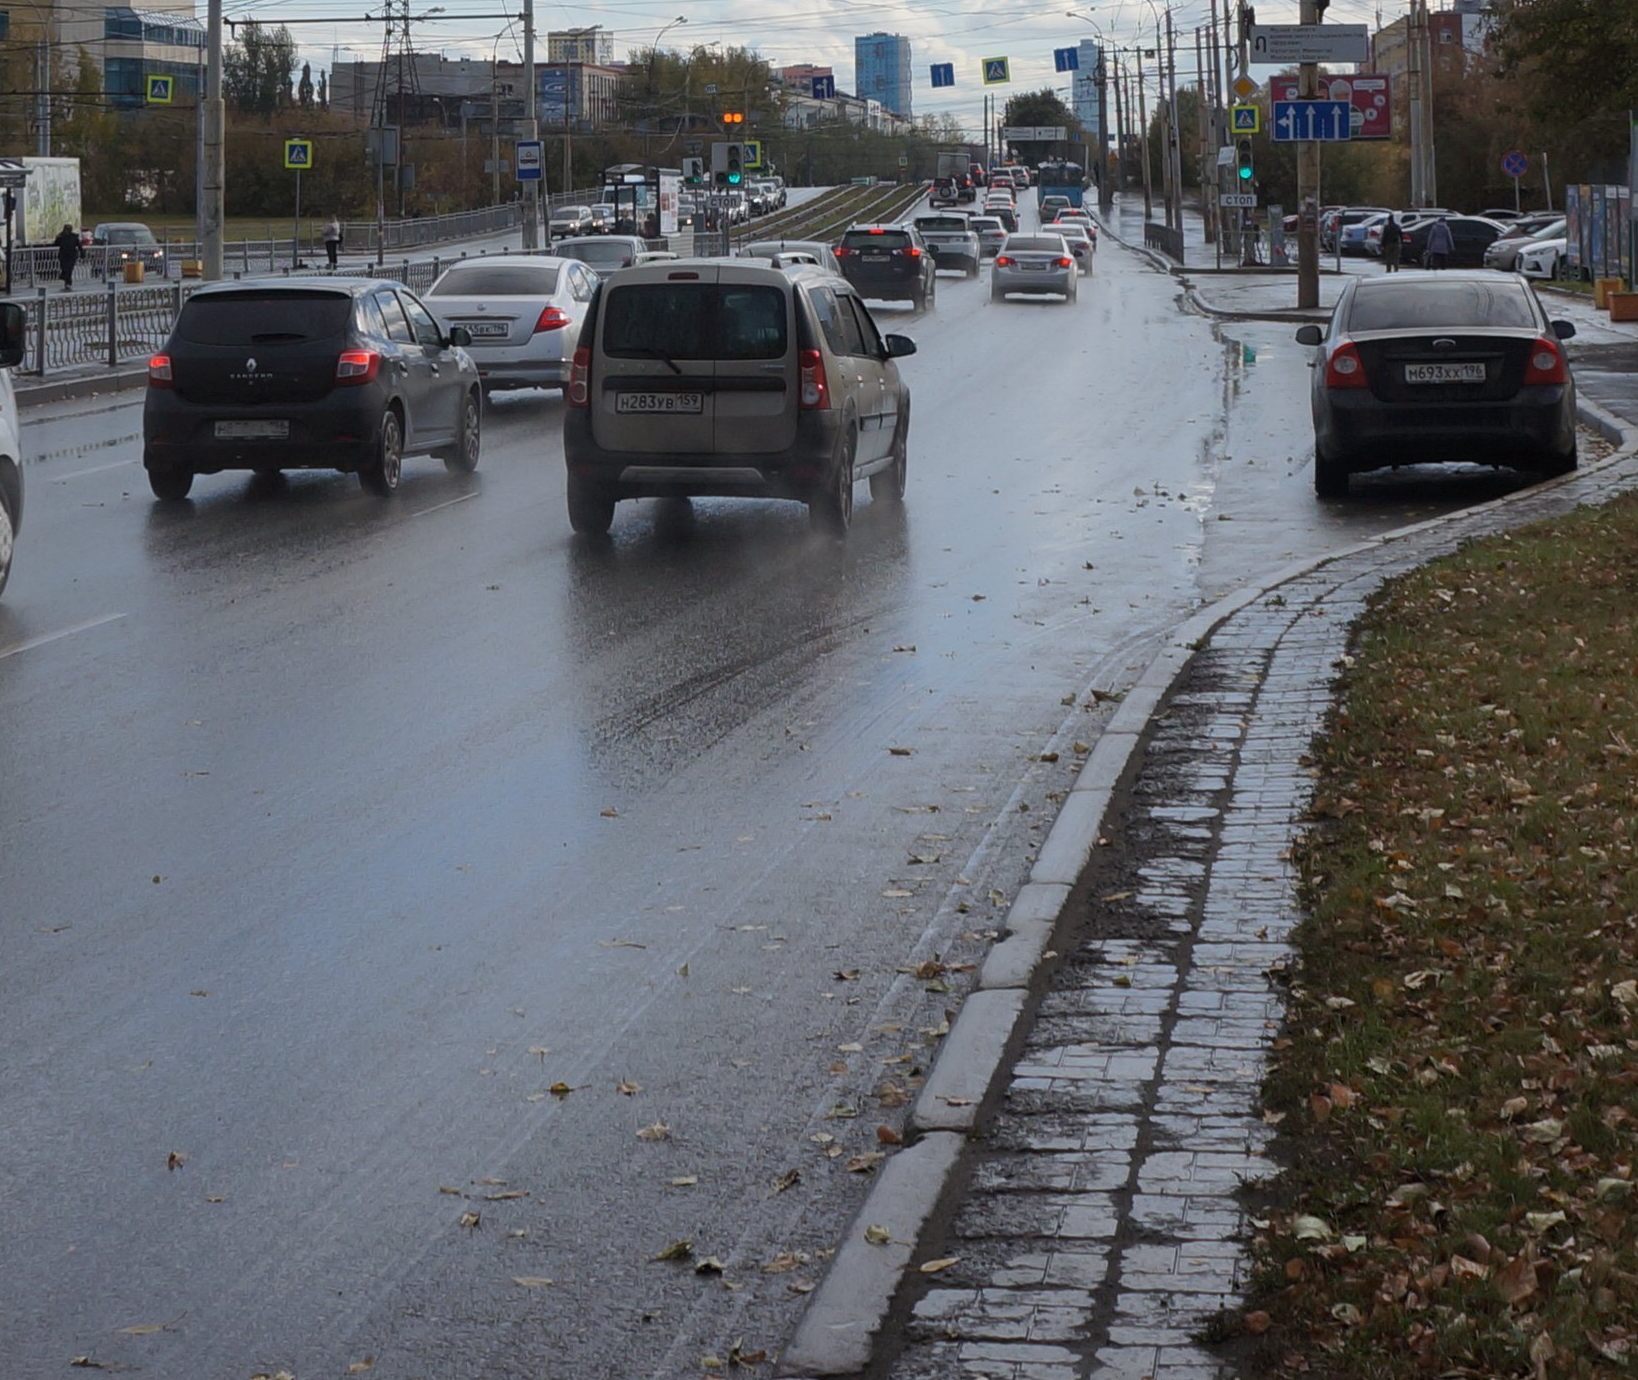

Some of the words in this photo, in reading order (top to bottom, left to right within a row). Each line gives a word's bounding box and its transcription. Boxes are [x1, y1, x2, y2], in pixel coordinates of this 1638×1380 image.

[711, 197, 737, 207] СТОП
[1226, 196, 1253, 205] СТОП
[1464, 365, 1484, 377] 196
[676, 393, 699, 407] 159
